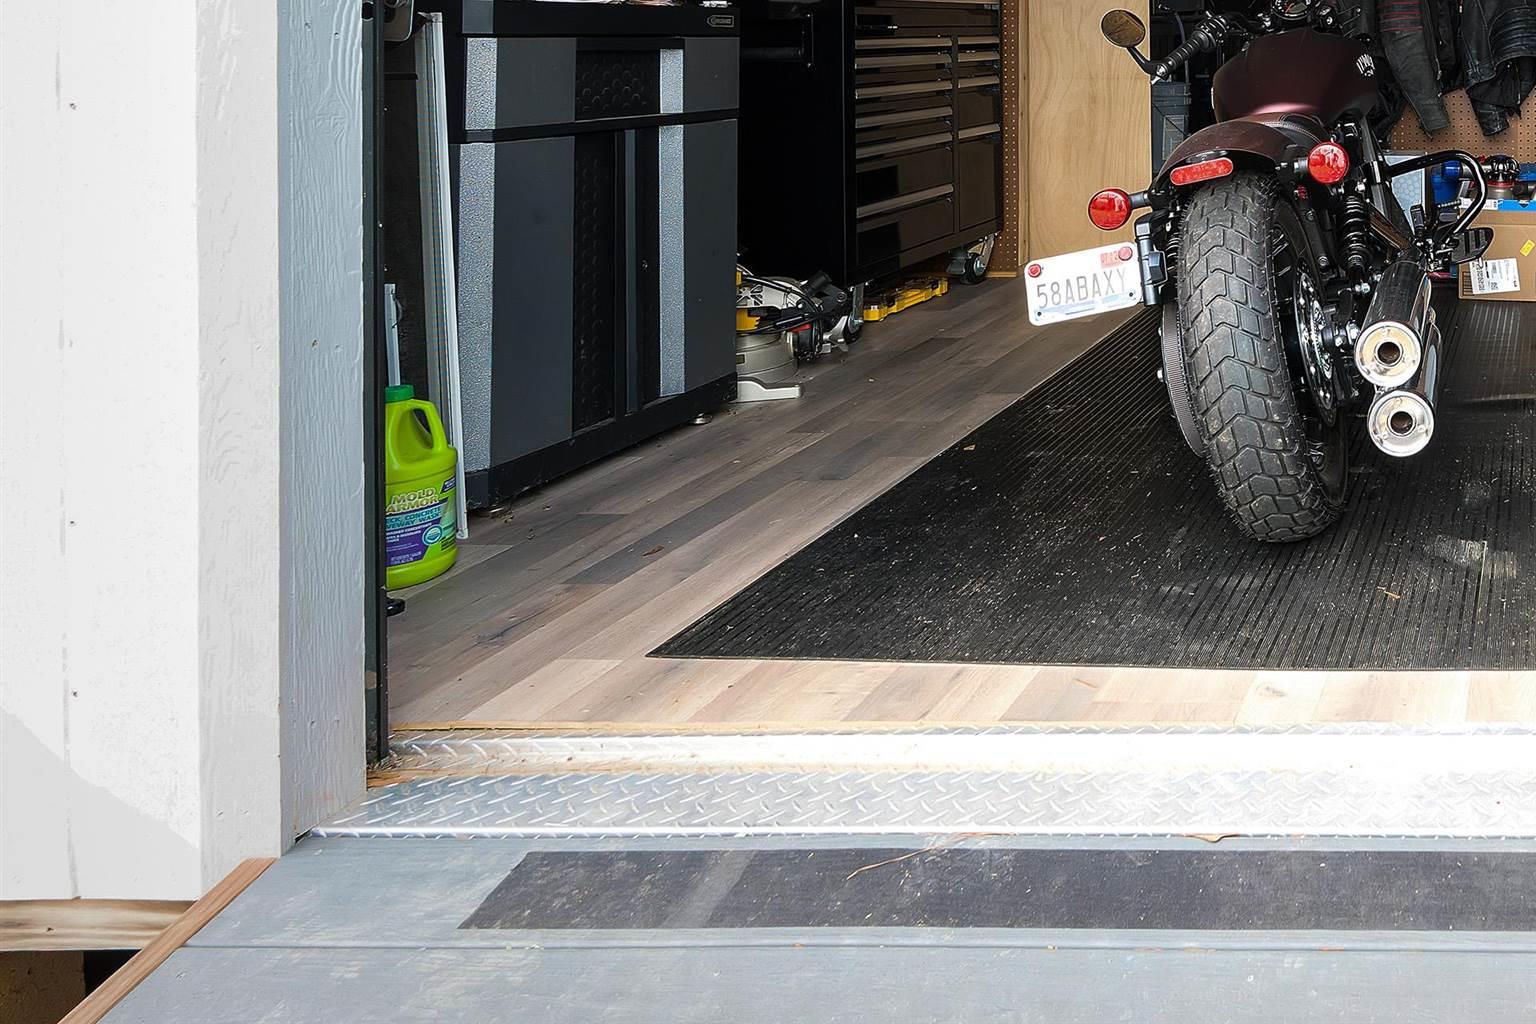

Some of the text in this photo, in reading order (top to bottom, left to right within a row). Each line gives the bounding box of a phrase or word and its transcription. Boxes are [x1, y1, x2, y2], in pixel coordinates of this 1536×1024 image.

[1036, 267, 1126, 309] 58ABAXY
[386, 494, 440, 513] ARMOR
[391, 487, 436, 505] MOLD
